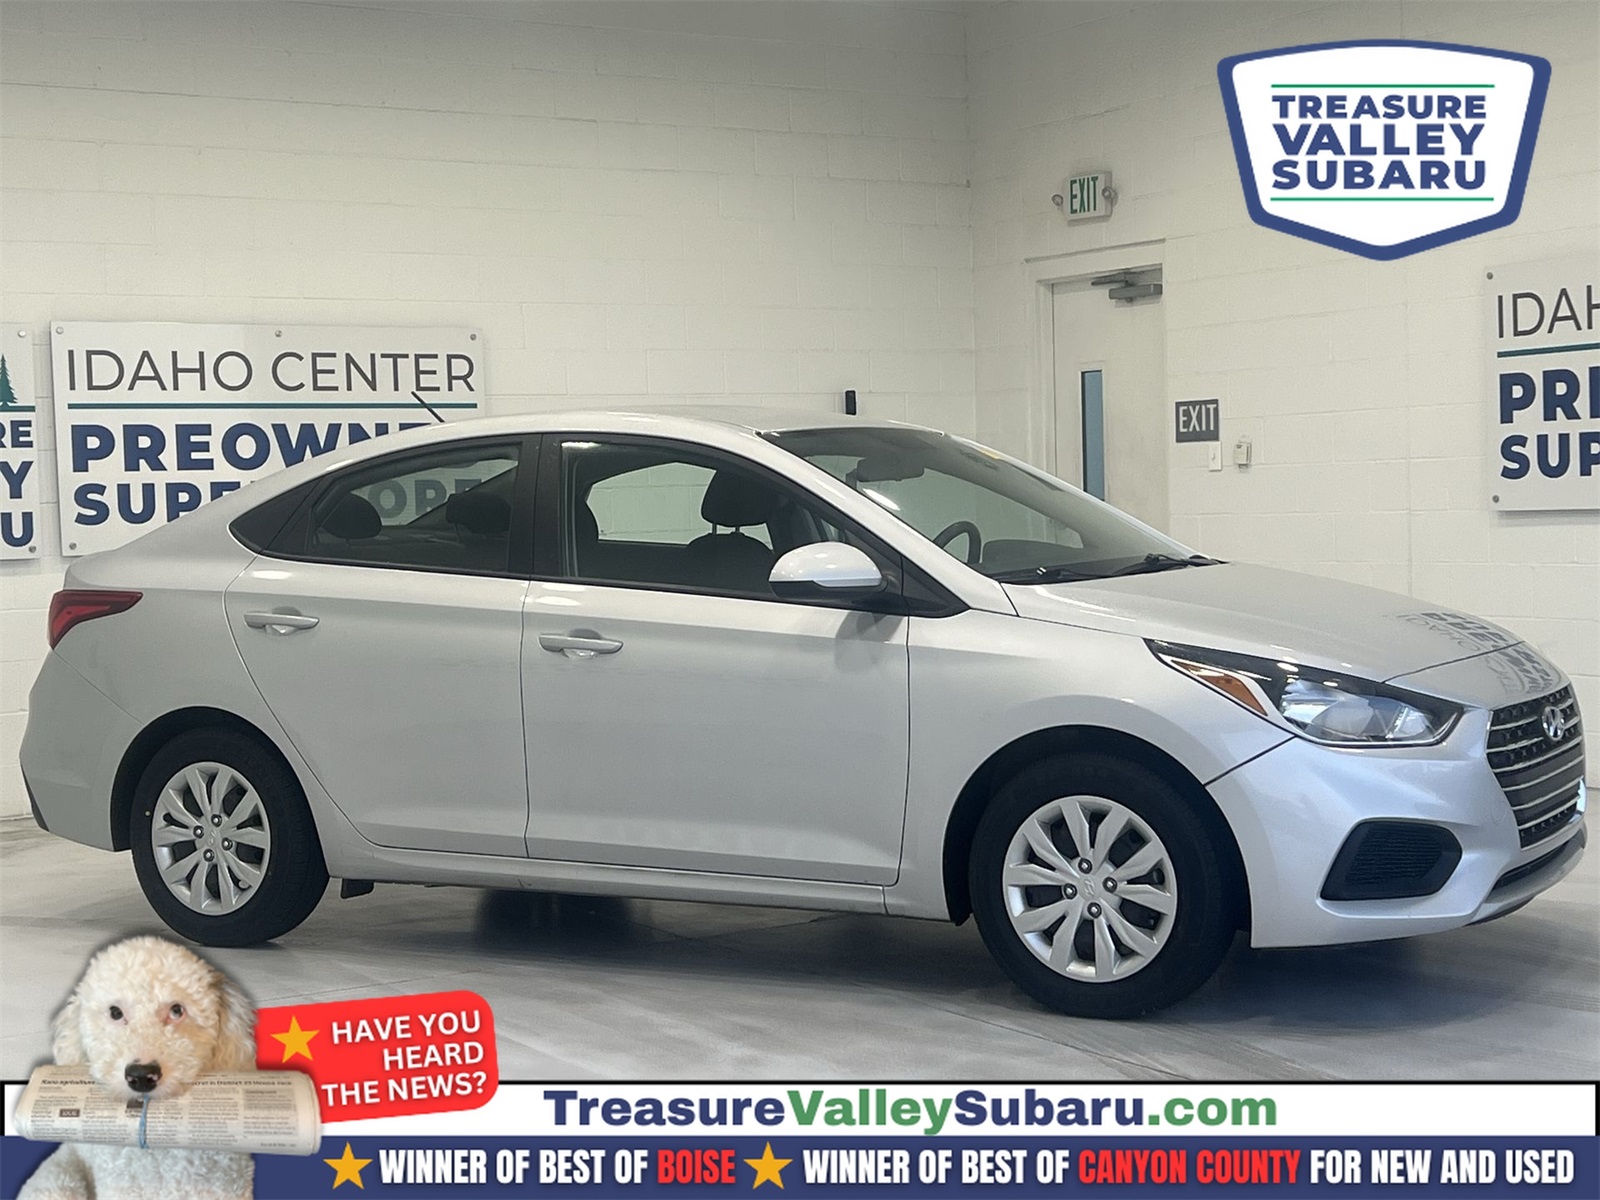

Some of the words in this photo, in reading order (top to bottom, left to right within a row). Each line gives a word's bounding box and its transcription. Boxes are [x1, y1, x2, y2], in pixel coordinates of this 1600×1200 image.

[1069, 175, 1099, 215] EXIT
[67, 349, 253, 392] IDAHO
[271, 351, 476, 393] CENTER
[0, 420, 34, 449] E
[1178, 403, 1217, 433] EXIT
[71, 422, 432, 472] PREOW
